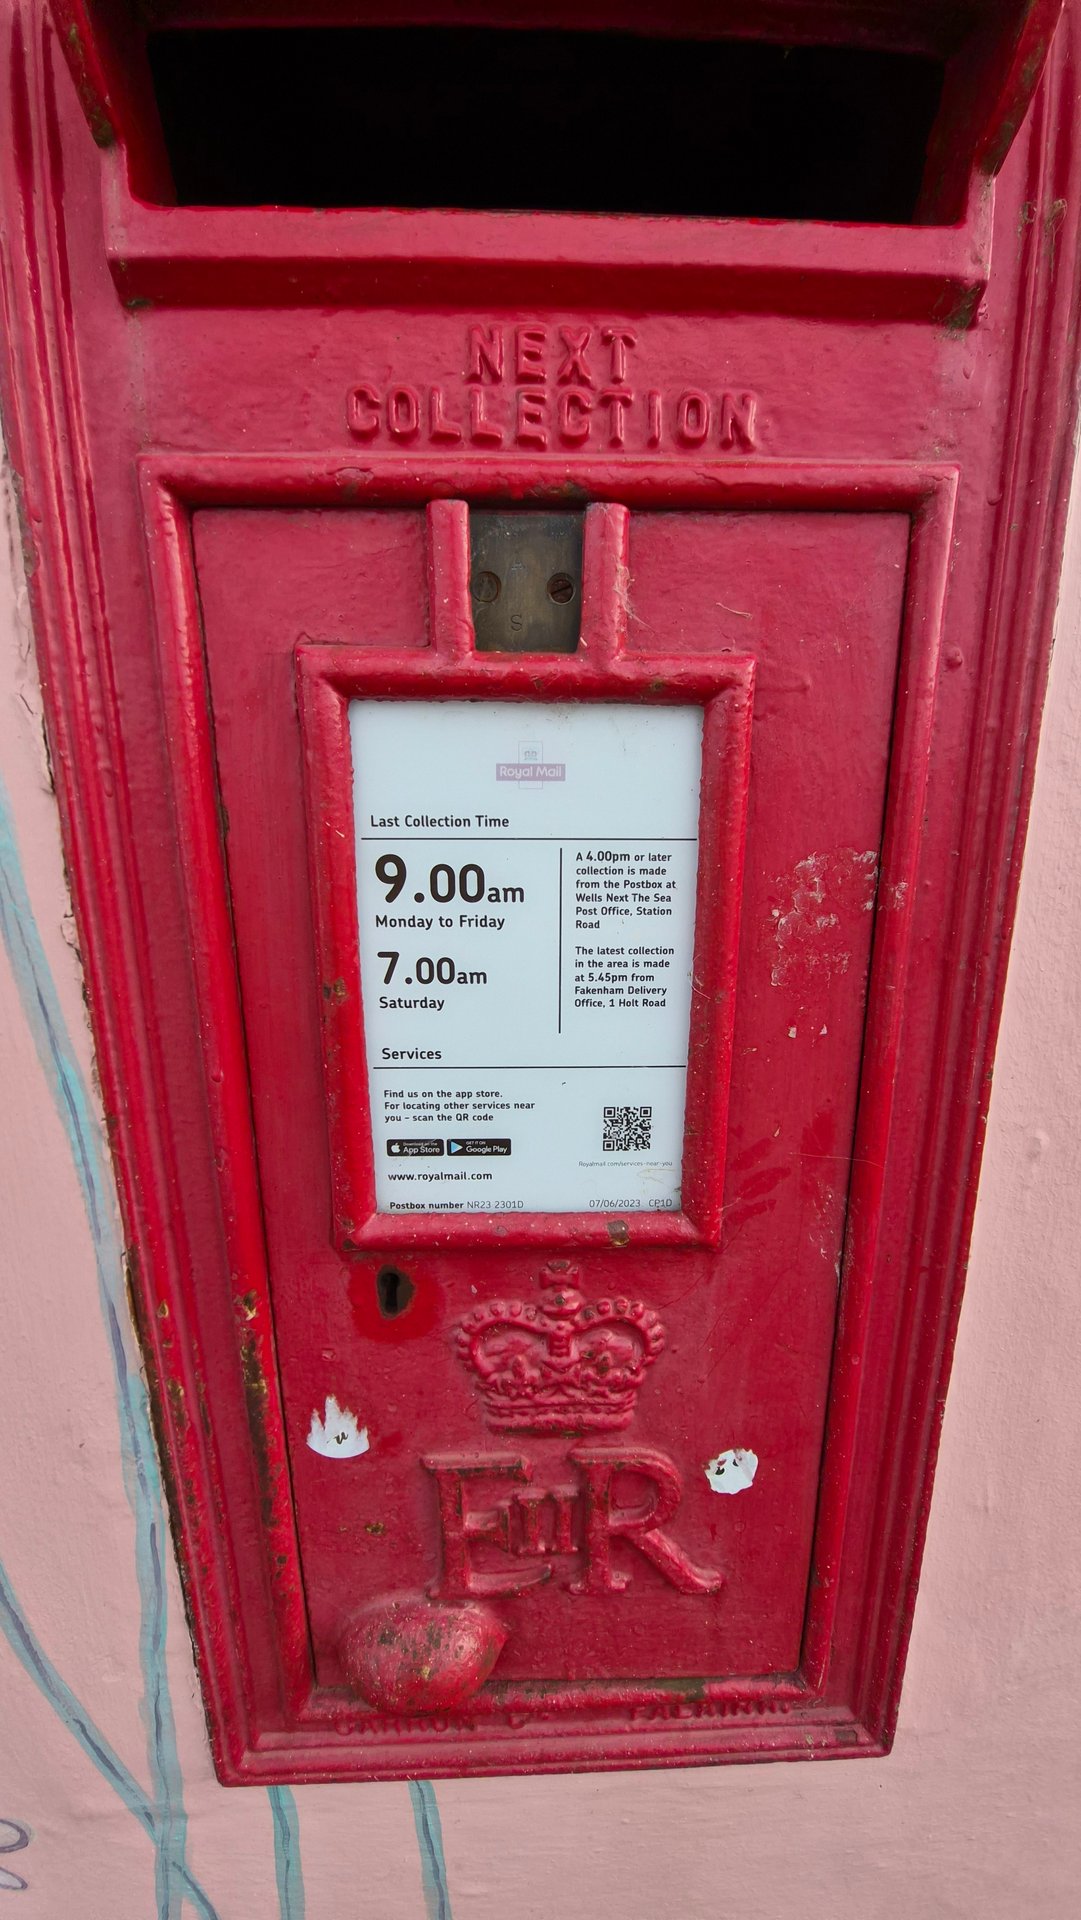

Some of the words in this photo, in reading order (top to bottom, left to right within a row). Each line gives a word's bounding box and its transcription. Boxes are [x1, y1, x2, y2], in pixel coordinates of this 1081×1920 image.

[466, 324, 638, 385] NEXT
[346, 383, 758, 451] COLLECTION
[510, 614, 522, 631] S
[500, 766, 533, 778] Royal
[536, 766, 561, 777] Mail
[370, 815, 400, 827] Last
[405, 815, 471, 827] Collection
[475, 815, 509, 827] Time
[576, 852, 582, 861] A
[586, 851, 630, 863] 4.00pm
[649, 853, 672, 861] later
[576, 866, 623, 875] collection
[628, 866, 635, 875] is
[640, 867, 666, 875] made
[375, 854, 524, 903] 9.00am
[576, 880, 599, 888] from
[604, 880, 619, 888] the
[624, 880, 662, 888] Postbox
[576, 893, 602, 902] Wells
[607, 894, 628, 902] Next
[632, 893, 650, 902] The
[654, 893, 671, 902] Sea
[576, 907, 597, 915] Post
[601, 907, 633, 916] Office,
[636, 907, 672, 915] Station
[375, 915, 433, 930] Monday
[439, 916, 453, 928] to
[460, 915, 505, 930] Friday
[576, 920, 600, 928] Road
[575, 947, 593, 955] The
[597, 947, 625, 955] latest
[628, 946, 674, 955] collection
[377, 952, 487, 984] 7.00am
[575, 959, 584, 968] in
[588, 960, 603, 968] the
[632, 960, 640, 968] is
[644, 960, 670, 968] made
[588, 973, 627, 983] 5.45pm
[631, 973, 654, 981] from
[575, 986, 624, 994] Fakenham
[628, 986, 667, 996] Delivery
[379, 997, 444, 1011] Saturday
[575, 999, 605, 1008] Office,
[609, 999, 614, 1007] 1
[619, 999, 639, 1007] Holt
[643, 999, 666, 1007] Road
[382, 1048, 442, 1059] Services
[384, 1090, 404, 1098] Find
[384, 1102, 400, 1110] For
[403, 1102, 440, 1111] locating
[385, 1115, 401, 1123] you
[456, 1114, 468, 1122] QR
[466, 1146, 491, 1154] Google
[493, 1146, 507, 1154] Play
[388, 1172, 492, 1182] www.royalmail.com
[495, 1201, 524, 1209] 2301D
[589, 1199, 640, 1208] 07/06/2023
